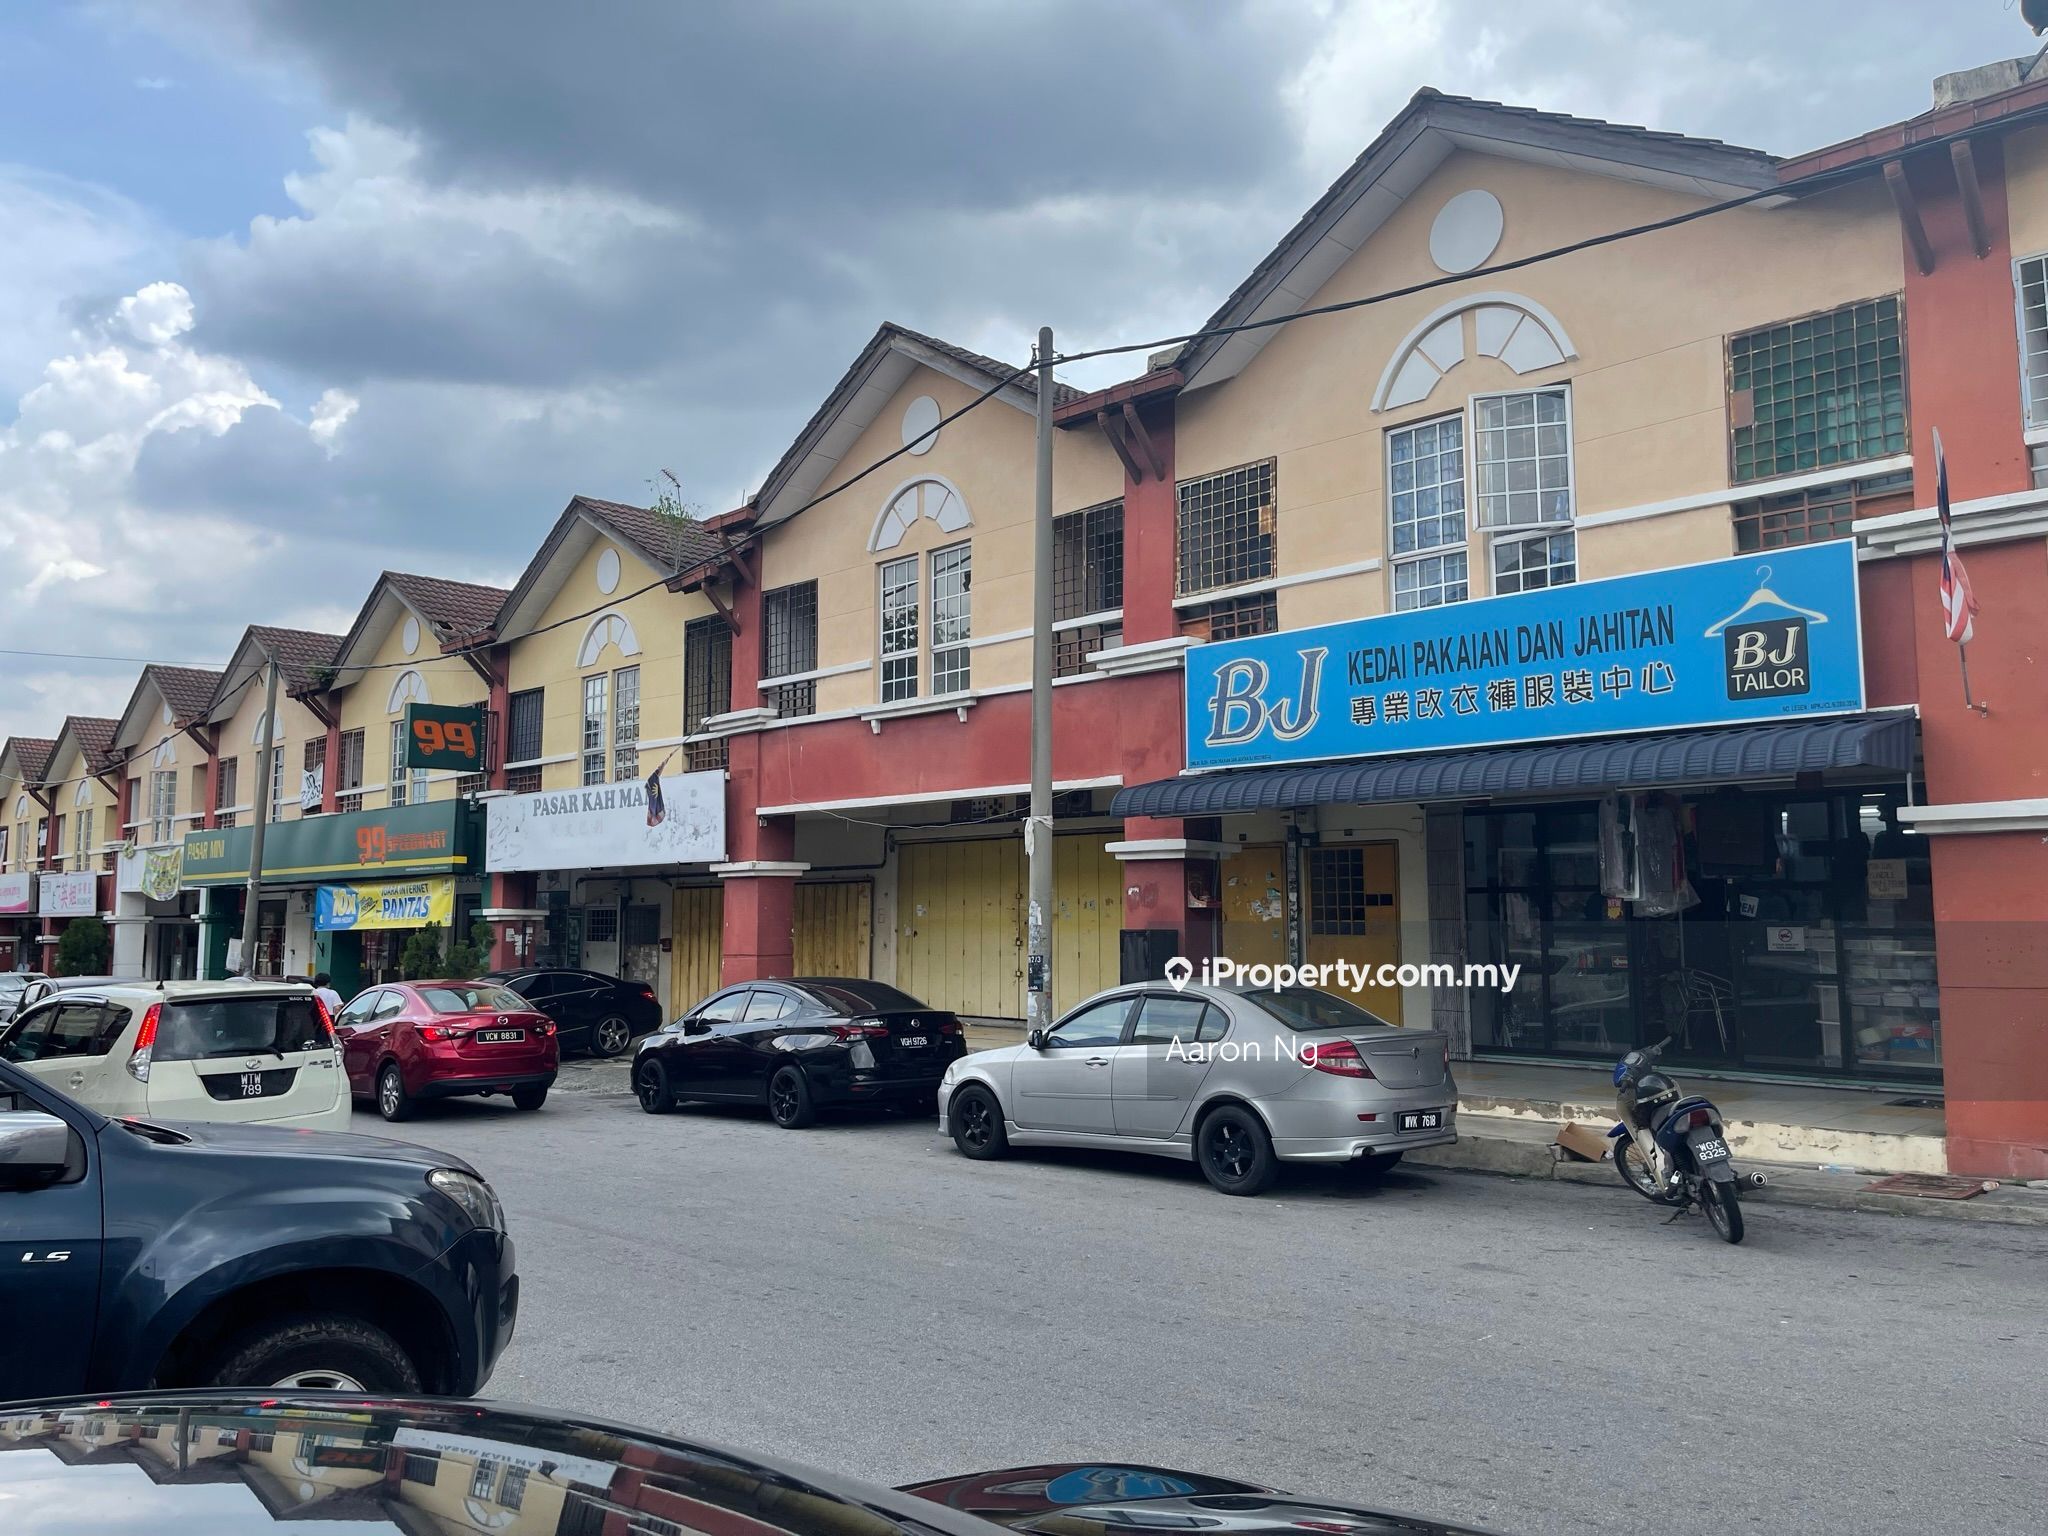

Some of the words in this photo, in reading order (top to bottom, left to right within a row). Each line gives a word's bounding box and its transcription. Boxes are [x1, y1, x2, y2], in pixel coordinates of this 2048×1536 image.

[1348, 642, 1406, 685] KEDAI
[1414, 628, 1509, 677] PAKAIAN
[1518, 620, 1564, 664] DAN
[1574, 604, 1674, 657] JAHITAN
[1733, 625, 1801, 671] BJ
[1731, 669, 1806, 693] TAILOR
[1205, 647, 1329, 748] BJ
[1350, 660, 1677, 726] 專業改衣褲服裝中心
[413, 719, 477, 759] 99
[532, 795, 579, 817] PASAR
[582, 790, 616, 812] KAH
[187, 842, 208, 861] PASAR
[209, 839, 225, 858] MINI
[356, 826, 386, 865] 99
[399, 882, 430, 895] INTERNET
[381, 896, 432, 920] PANTAS
[485, 1032, 498, 1041] VCW
[500, 1031, 517, 1040] 8831
[900, 1037, 912, 1047] VGH
[912, 1036, 927, 1046] 9726
[240, 1073, 262, 1085] WTW
[240, 1084, 262, 1096] 789
[1698, 1139, 1720, 1151] WGX
[1699, 1147, 1727, 1161] 8325
[21, 1251, 71, 1263] LS
